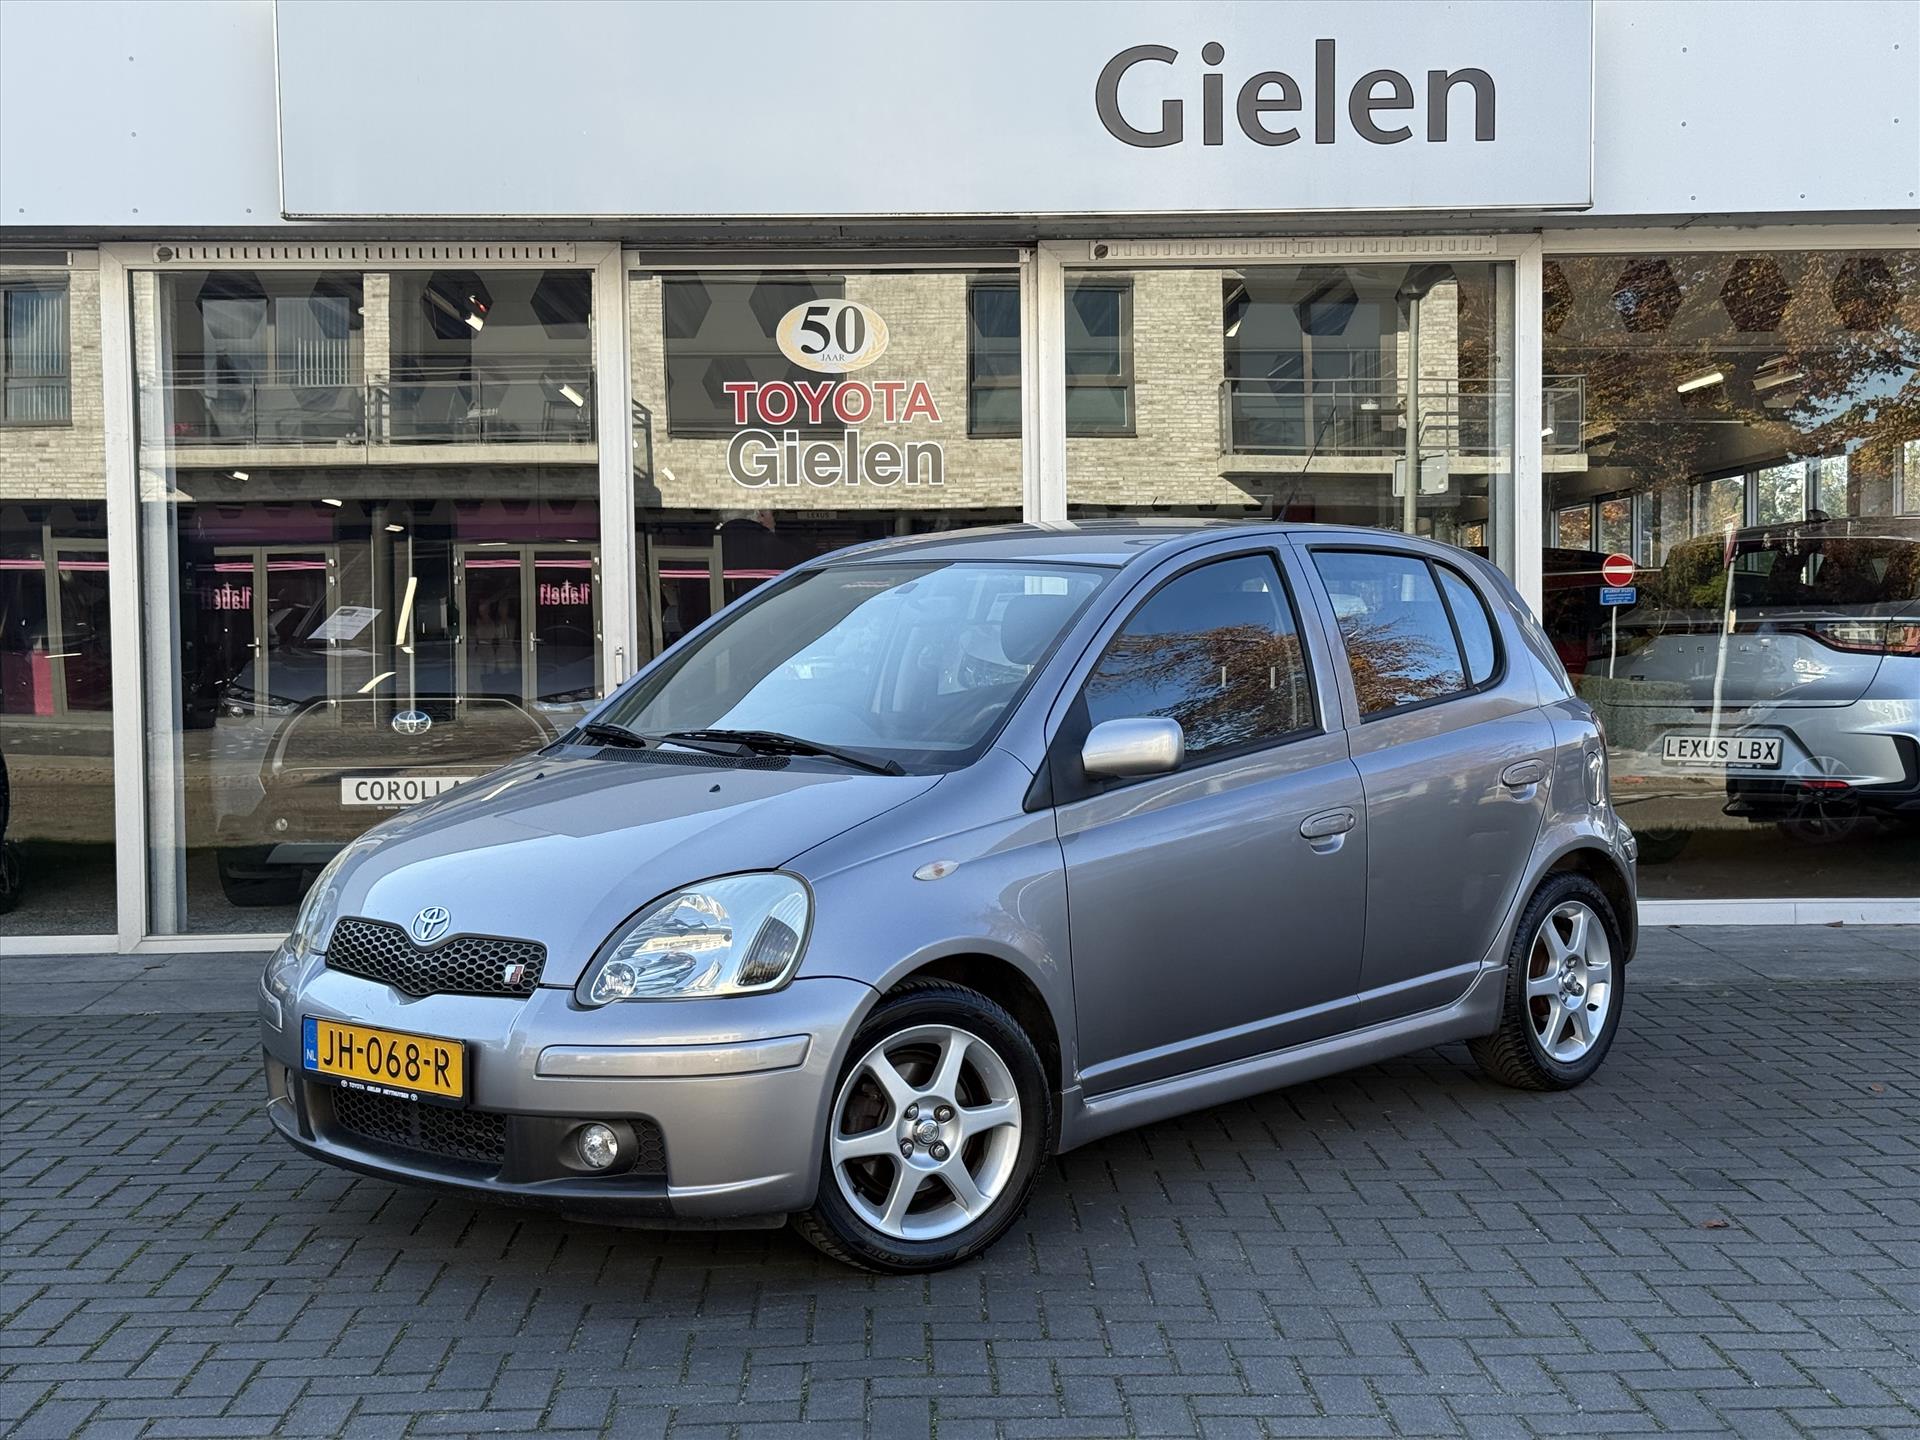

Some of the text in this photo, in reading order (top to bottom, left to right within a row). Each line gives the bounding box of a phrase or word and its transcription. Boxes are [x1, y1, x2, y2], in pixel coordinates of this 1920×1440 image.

[1095, 39, 1496, 148] Gielen
[800, 306, 866, 354] 50
[820, 353, 845, 362] JAAR
[724, 381, 943, 425] TOYOTA
[727, 429, 944, 488] Gielen
[1666, 739, 1776, 761] LEXUS LBX
[306, 1049, 317, 1062] NL
[323, 1030, 452, 1088] JH-068-R
[349, 1081, 365, 1091] TOYOTA
